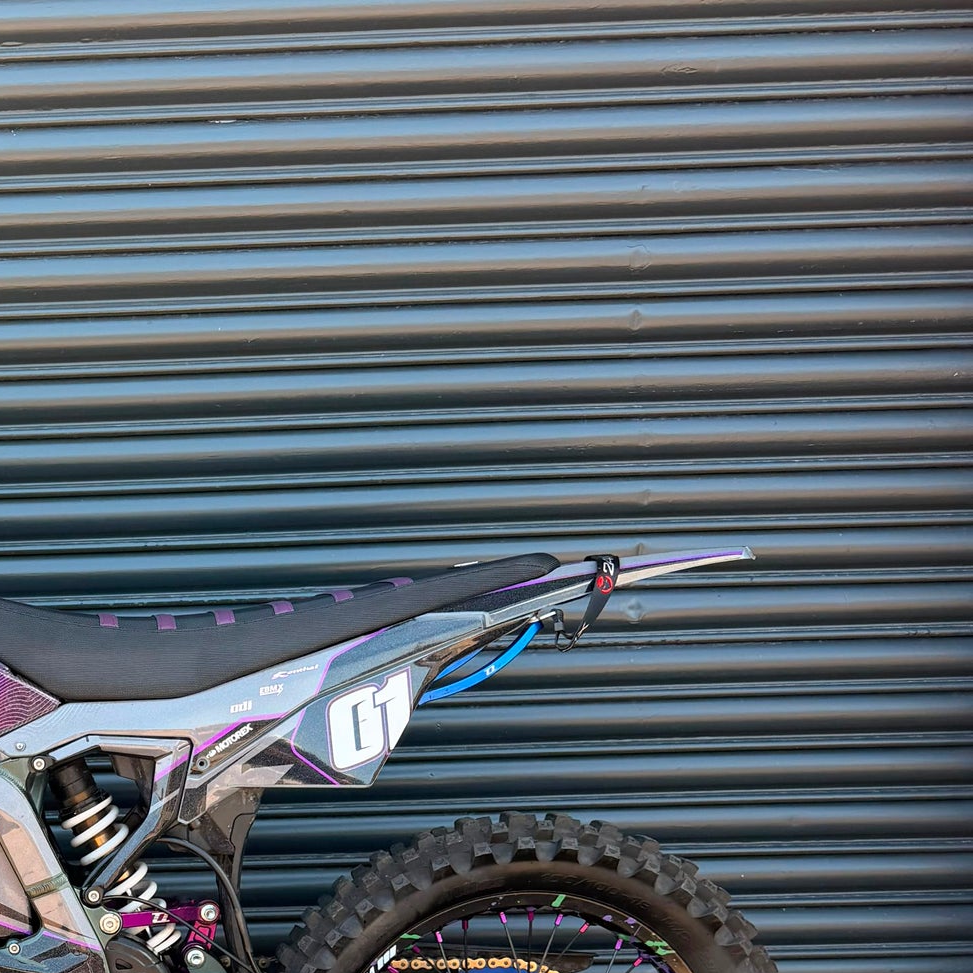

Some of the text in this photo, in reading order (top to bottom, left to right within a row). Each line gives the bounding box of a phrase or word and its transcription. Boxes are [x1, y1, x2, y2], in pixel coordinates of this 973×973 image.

[259, 683, 285, 697] EBMX
[326, 667, 413, 772] 01
[214, 722, 254, 754] MOTOREX
